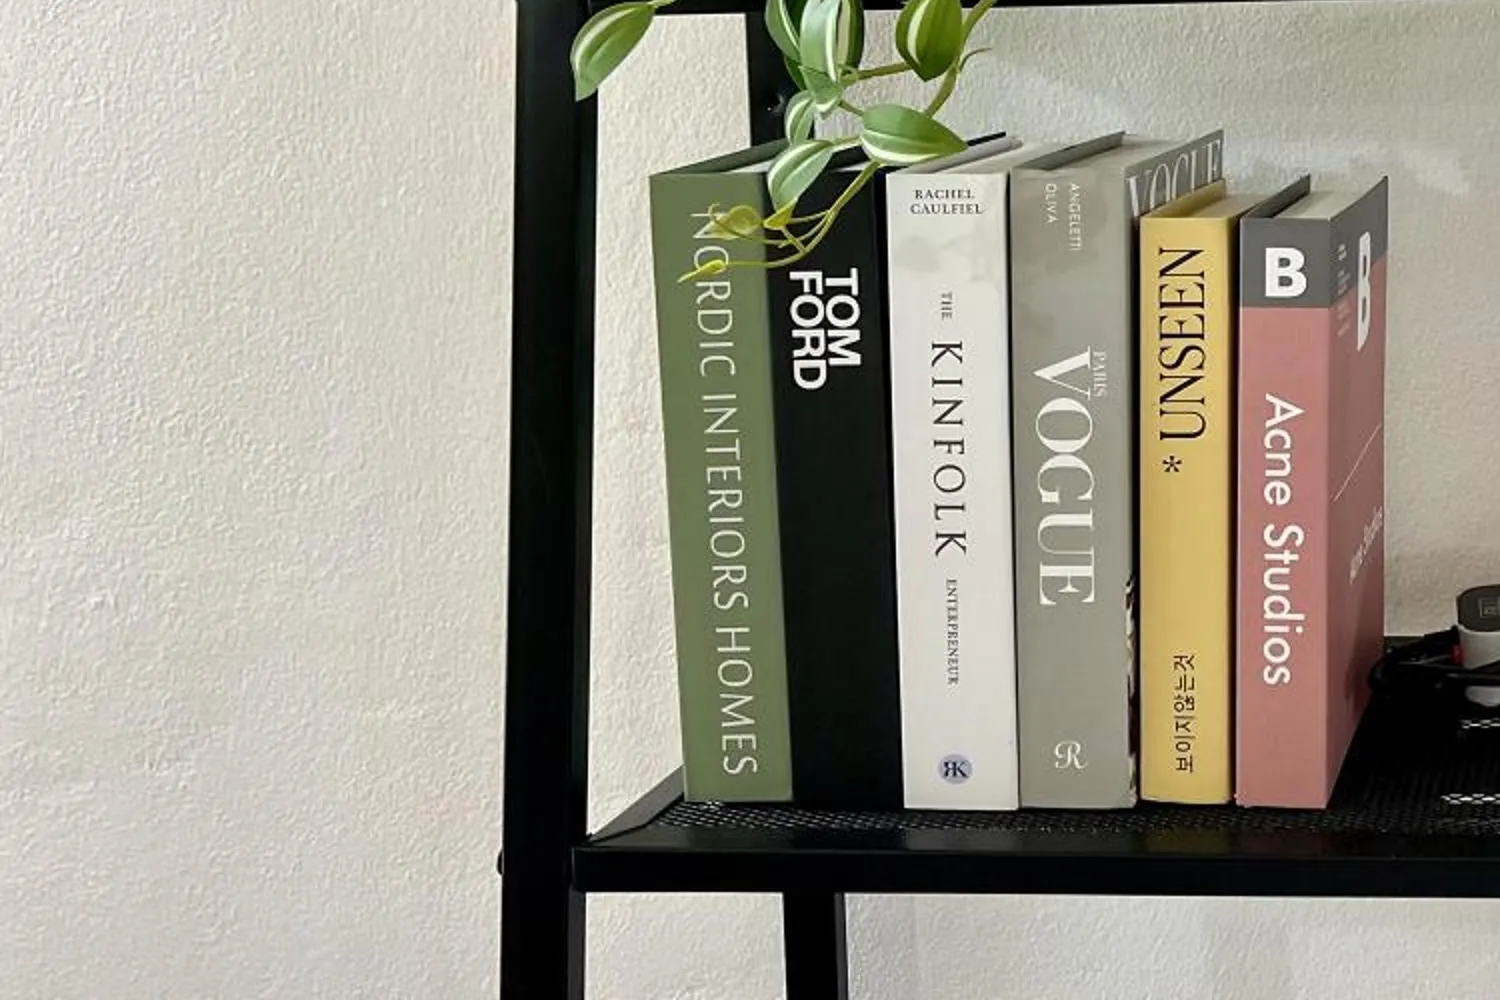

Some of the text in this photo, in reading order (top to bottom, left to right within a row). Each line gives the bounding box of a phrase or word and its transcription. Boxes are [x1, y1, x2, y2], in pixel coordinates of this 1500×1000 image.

[914, 189, 975, 200] RACHEL
[789, 270, 828, 390] FORD
[825, 267, 862, 367] TOM
[940, 291, 953, 320] THE
[1264, 247, 1307, 298] B
[1093, 351, 1108, 397] PARIS
[1158, 247, 1207, 441] UNSEEN
[703, 394, 748, 612] INTERIORS
[931, 341, 967, 557] KINFOLK
[1033, 346, 1095, 606] VOGUE
[1262, 393, 1305, 686] Acne Studios
[715, 626, 759, 775] HOMES
